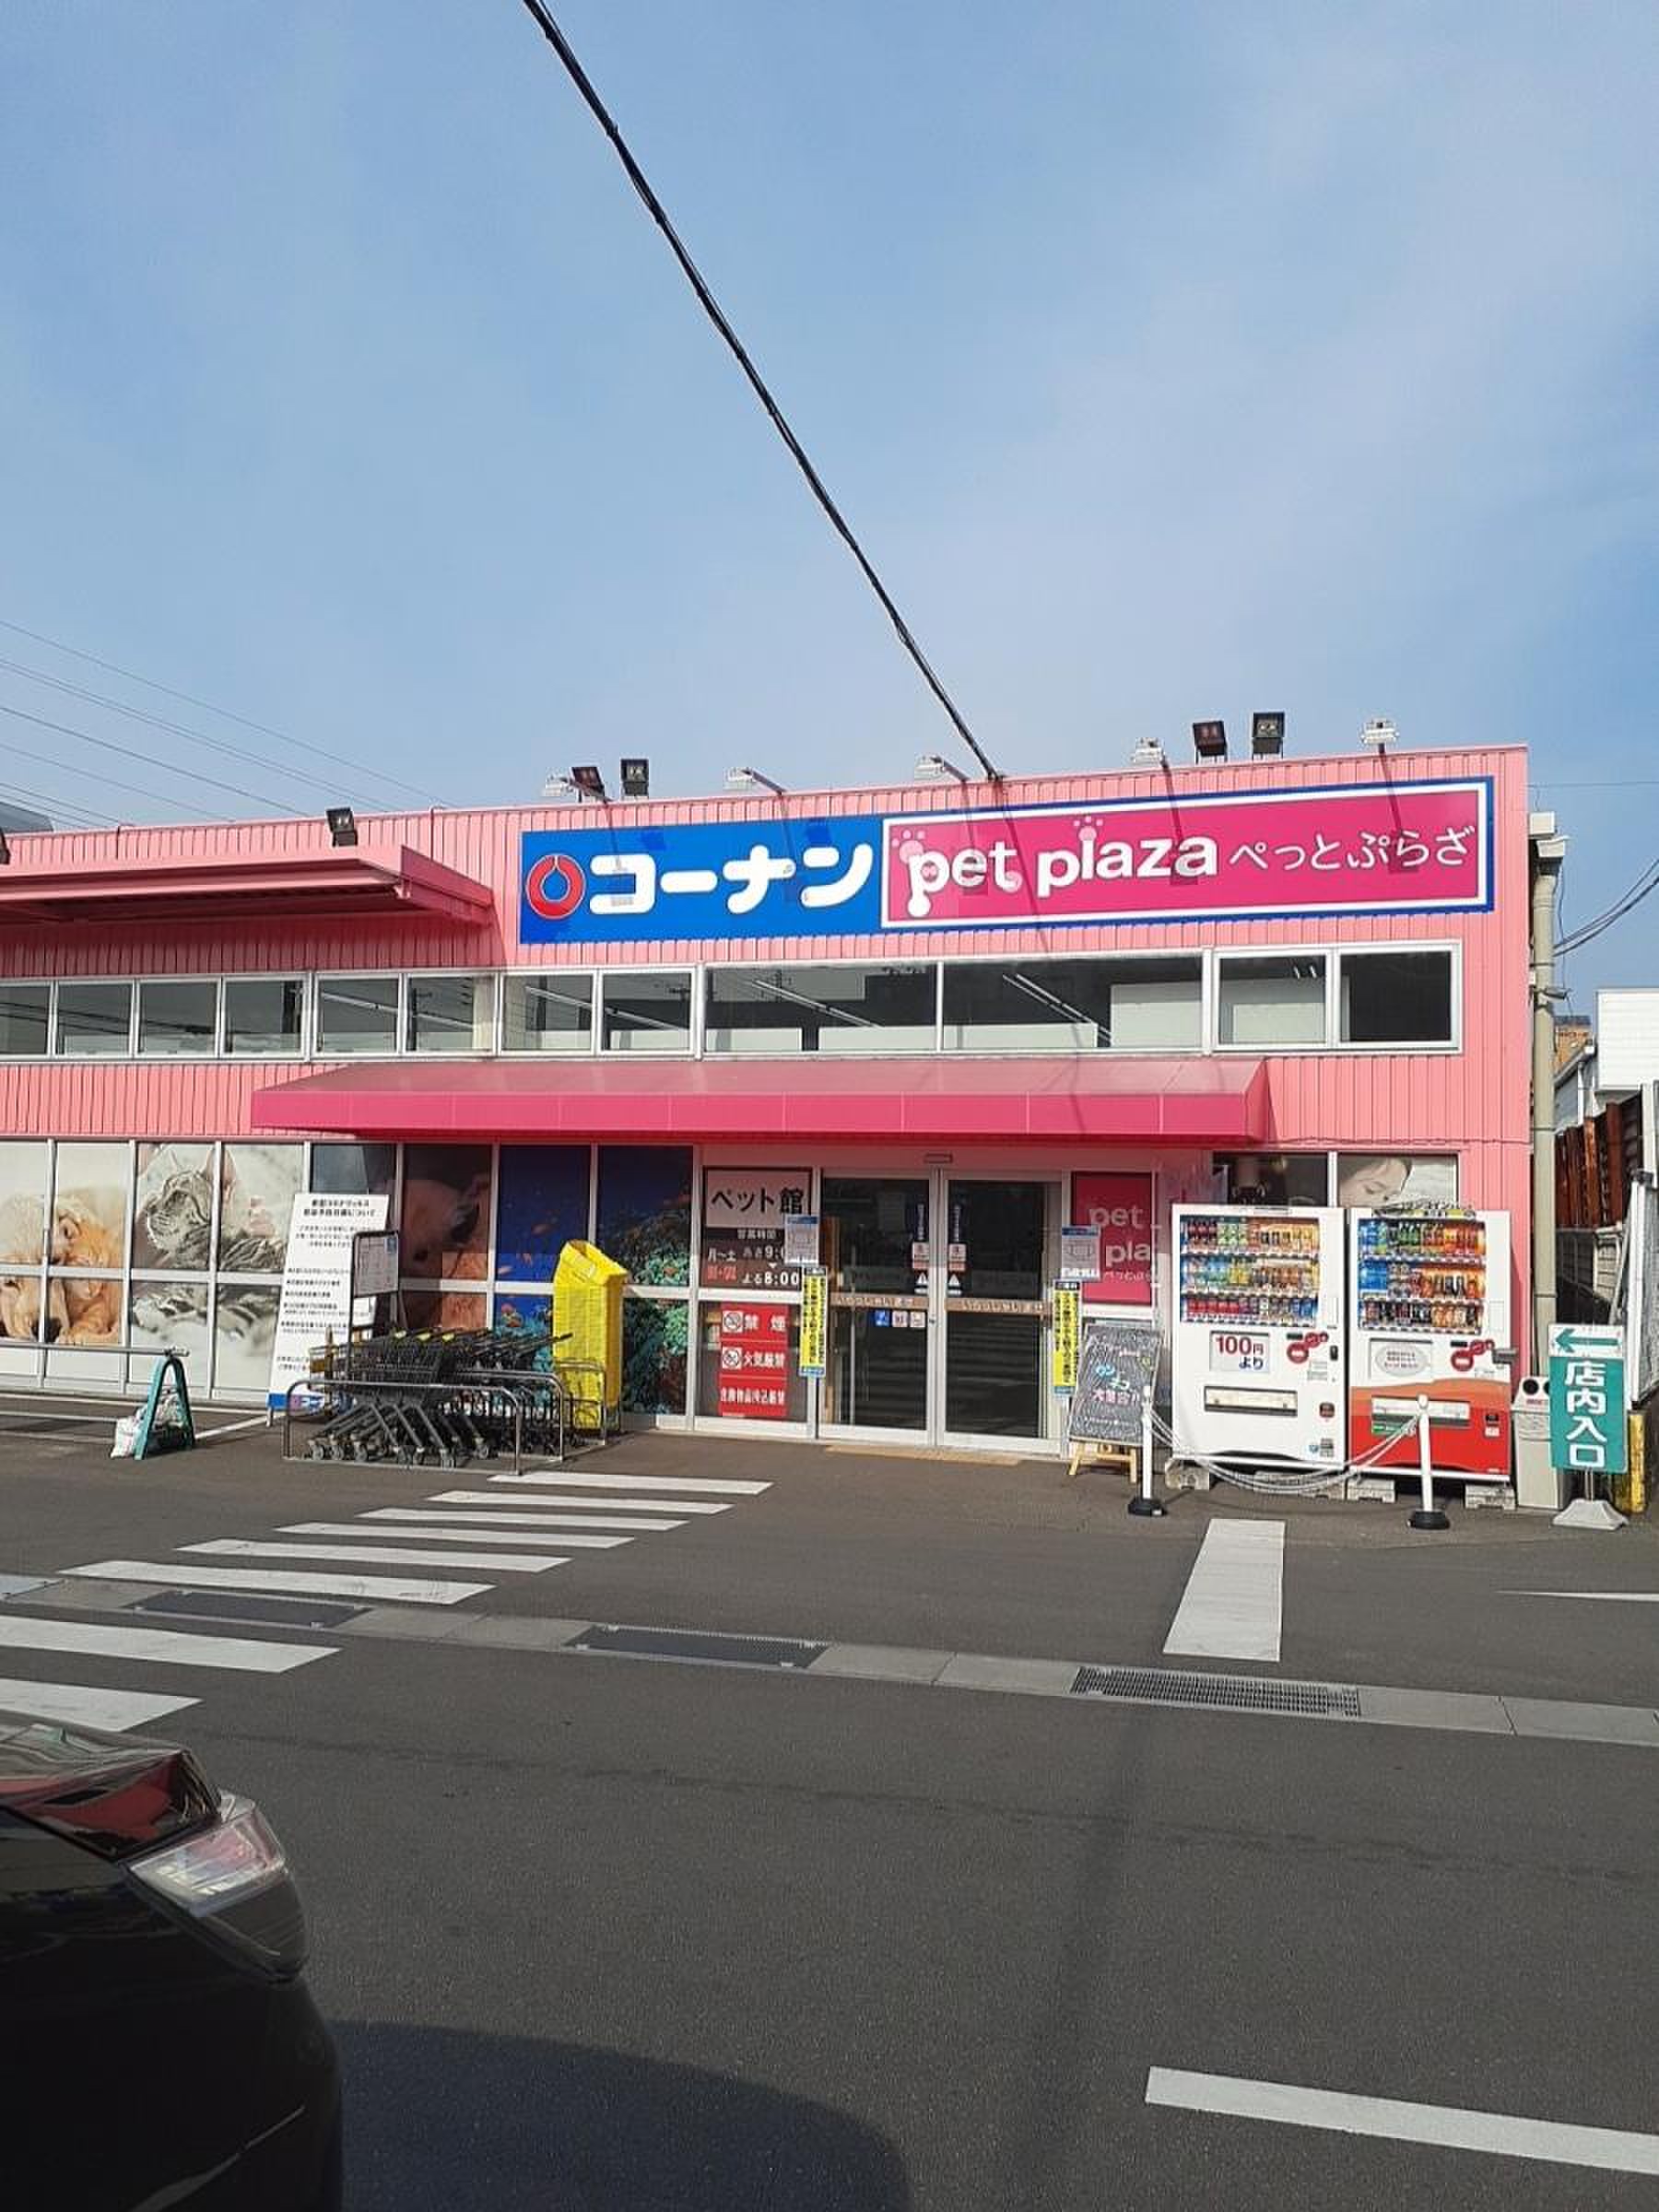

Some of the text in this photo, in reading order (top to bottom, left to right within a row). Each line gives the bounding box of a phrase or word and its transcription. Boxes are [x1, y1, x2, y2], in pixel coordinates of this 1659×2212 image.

[1229, 826, 1477, 872] ぺっとぷらざ
[589, 843, 874, 915] コーナン
[907, 832, 1218, 917] pet plaza
[711, 1187, 804, 1214] ペット館
[1089, 1205, 1145, 1230] pet
[1215, 1335, 1265, 1356] 100円
[1239, 1356, 1265, 1371] より
[1564, 1360, 1607, 1467] 店内入口
